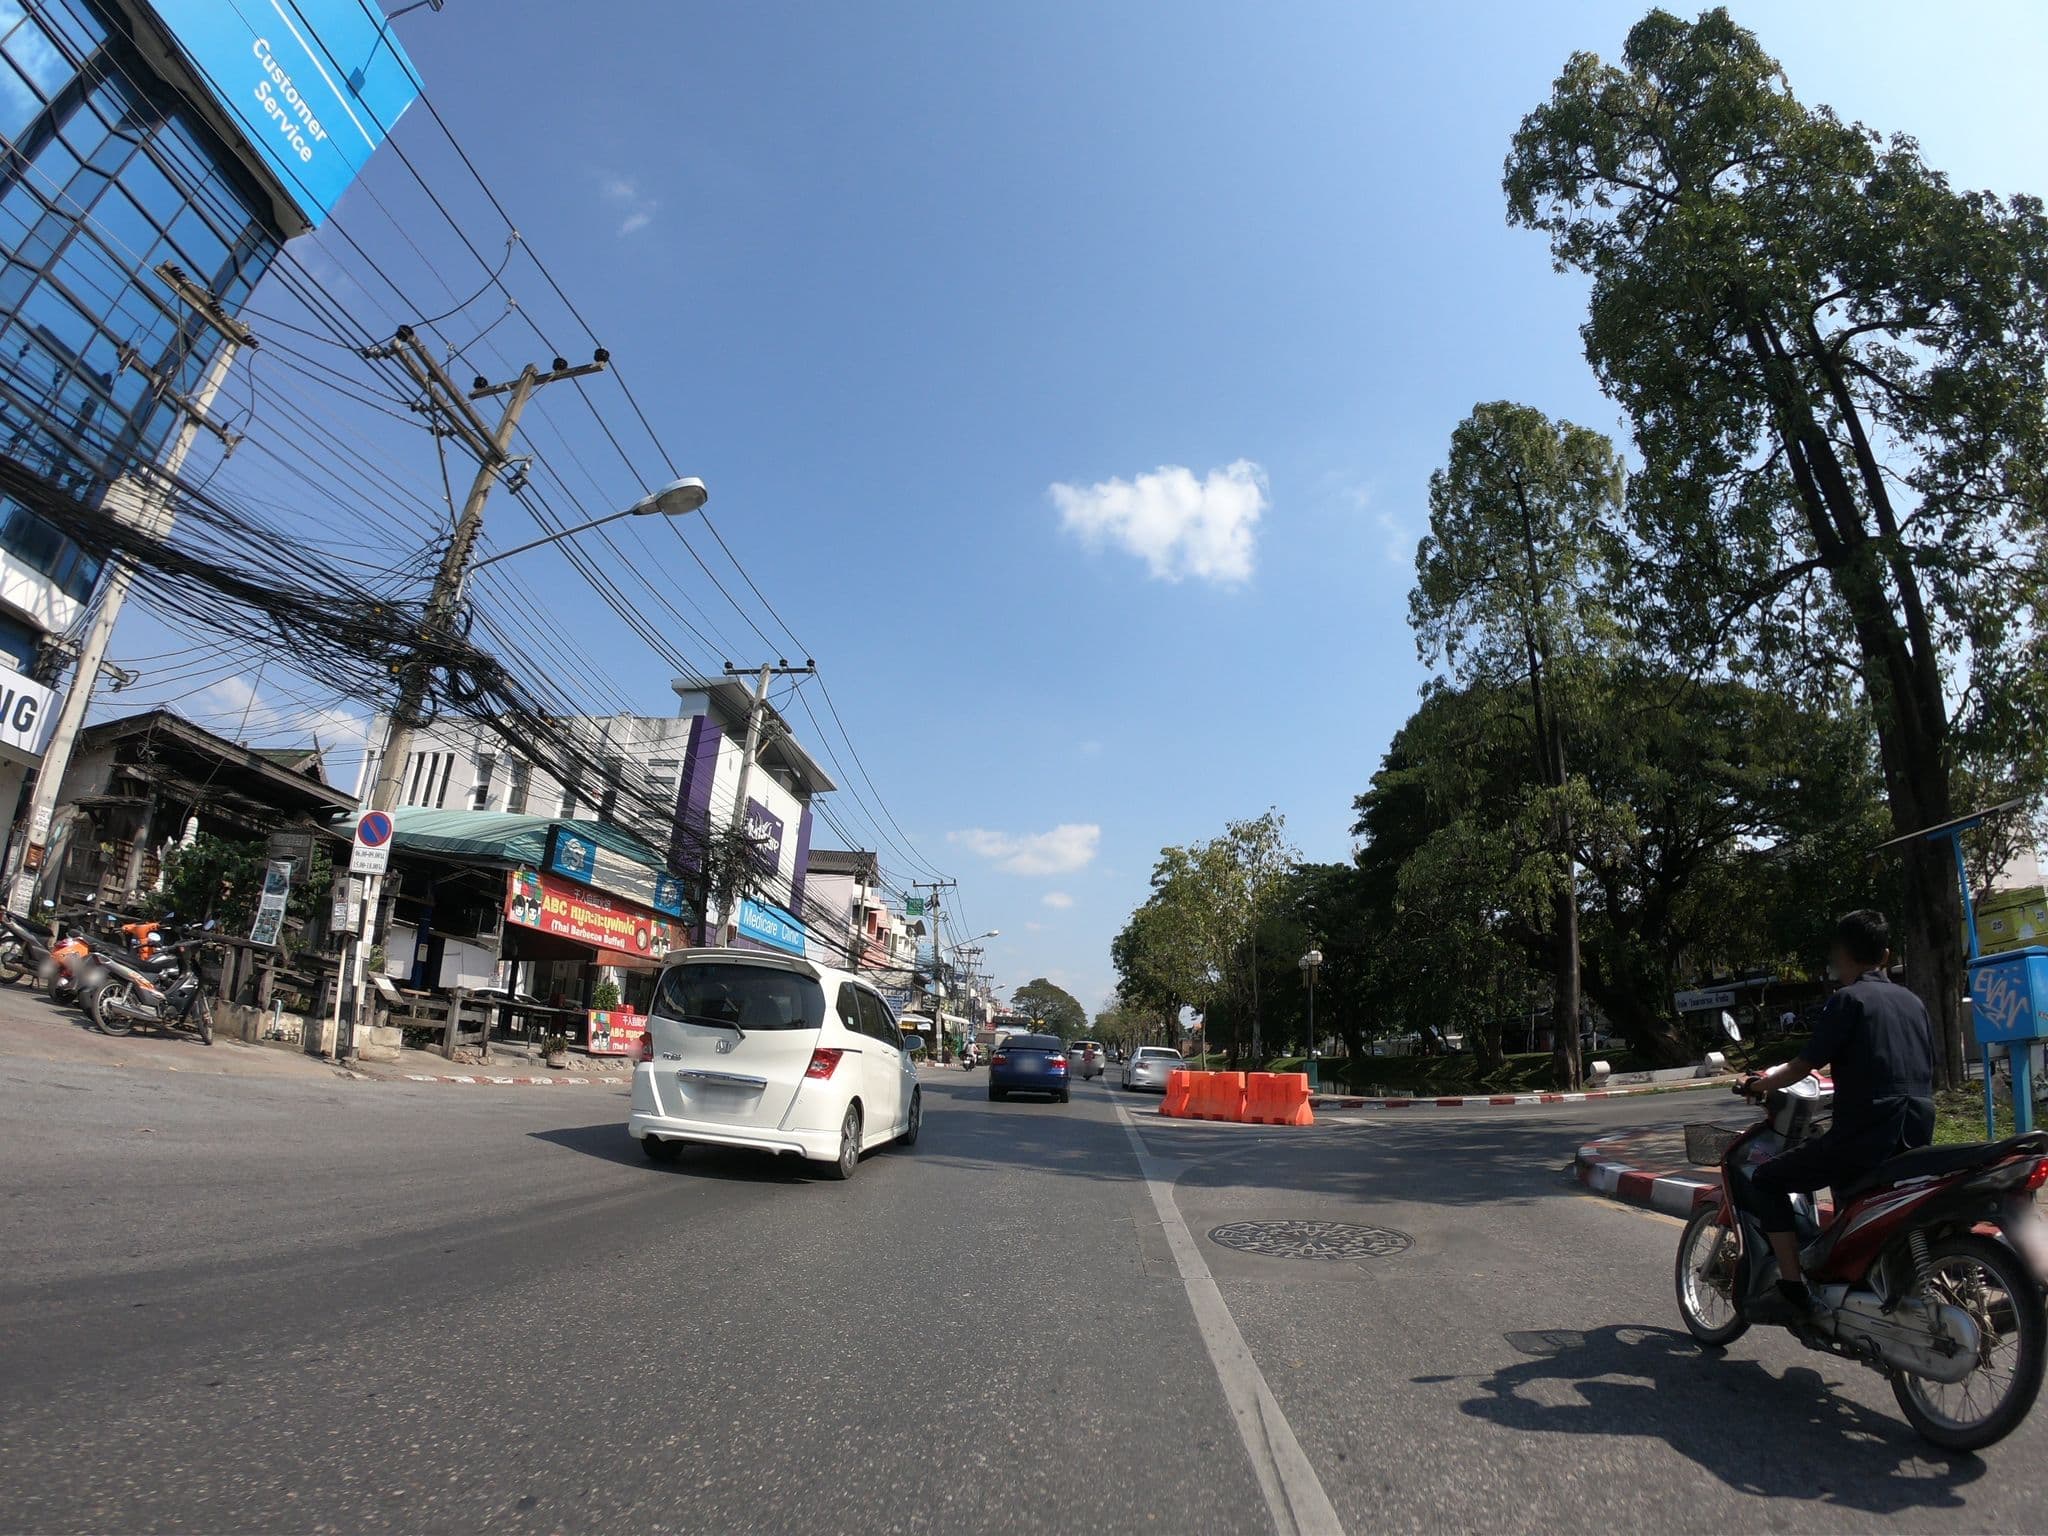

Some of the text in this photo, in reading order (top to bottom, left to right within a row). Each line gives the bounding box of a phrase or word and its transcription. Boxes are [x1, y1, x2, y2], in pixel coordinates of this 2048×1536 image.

[252, 37, 327, 142] Customer
[254, 80, 313, 163] Service
[542, 894, 567, 917] ABC
[571, 925, 603, 943] Barbecue
[743, 910, 800, 945] Medicare Clinic
[1992, 921, 2003, 930] 25
[610, 1027, 625, 1038] ABC
